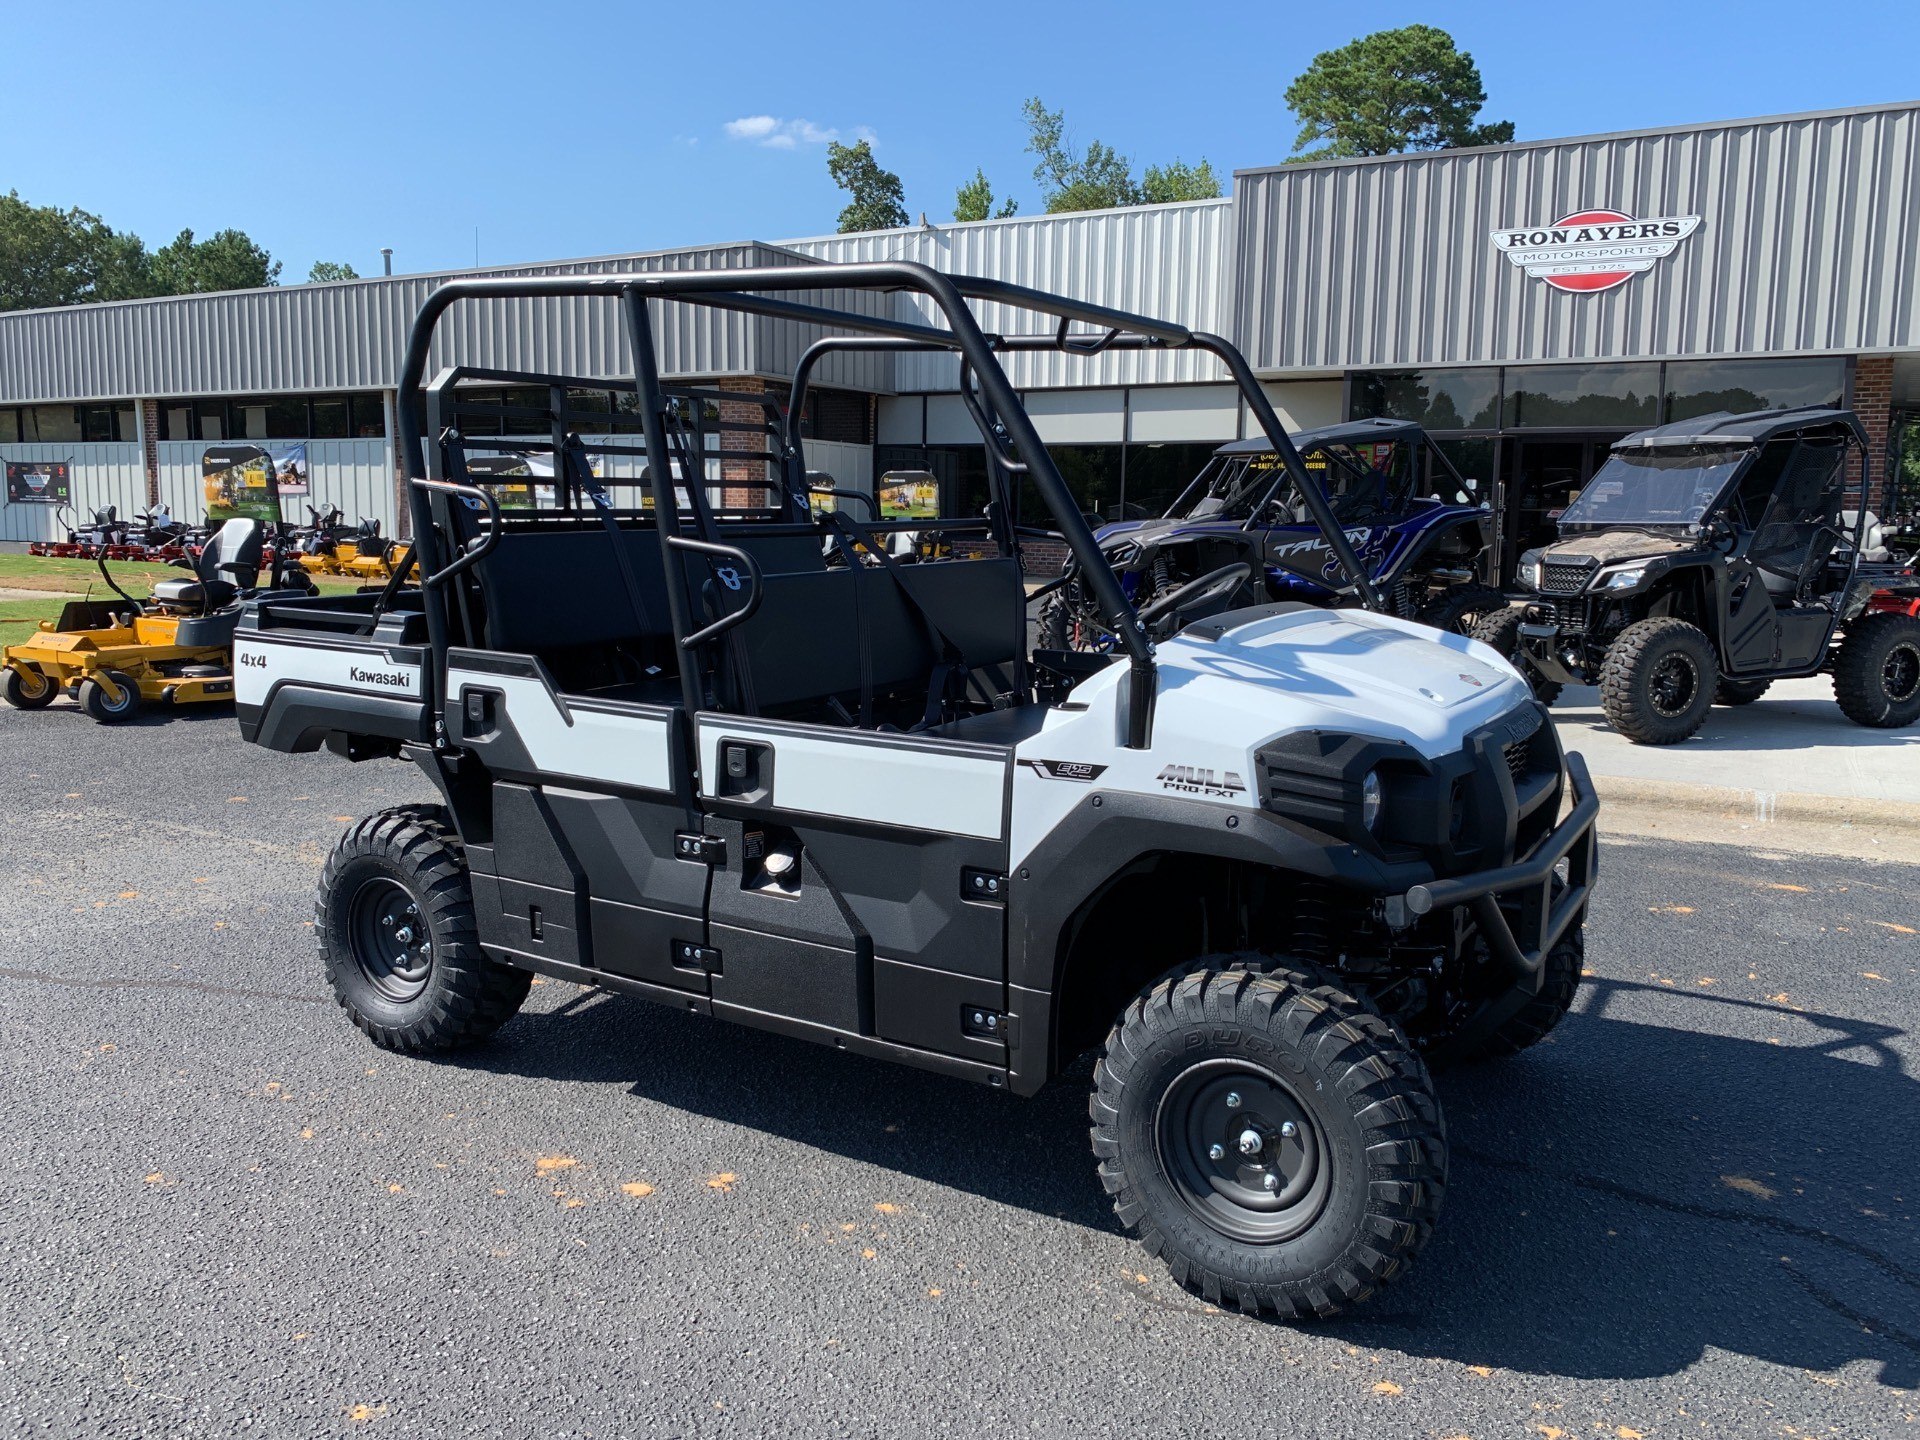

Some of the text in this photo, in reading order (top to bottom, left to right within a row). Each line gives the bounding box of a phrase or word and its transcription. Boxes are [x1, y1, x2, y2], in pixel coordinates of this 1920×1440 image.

[1507, 221, 1681, 247] RON AYERS
[1523, 246, 1659, 261] MOTORSPORTS
[1273, 527, 1372, 558] TALN
[241, 653, 267, 668] 4x4
[350, 667, 410, 687] Kawasaki
[1056, 763, 1092, 776] EPS
[1156, 764, 1247, 791] MULE
[1163, 782, 1238, 798] PRO-FXT
[1184, 1029, 1305, 1074] DURO
